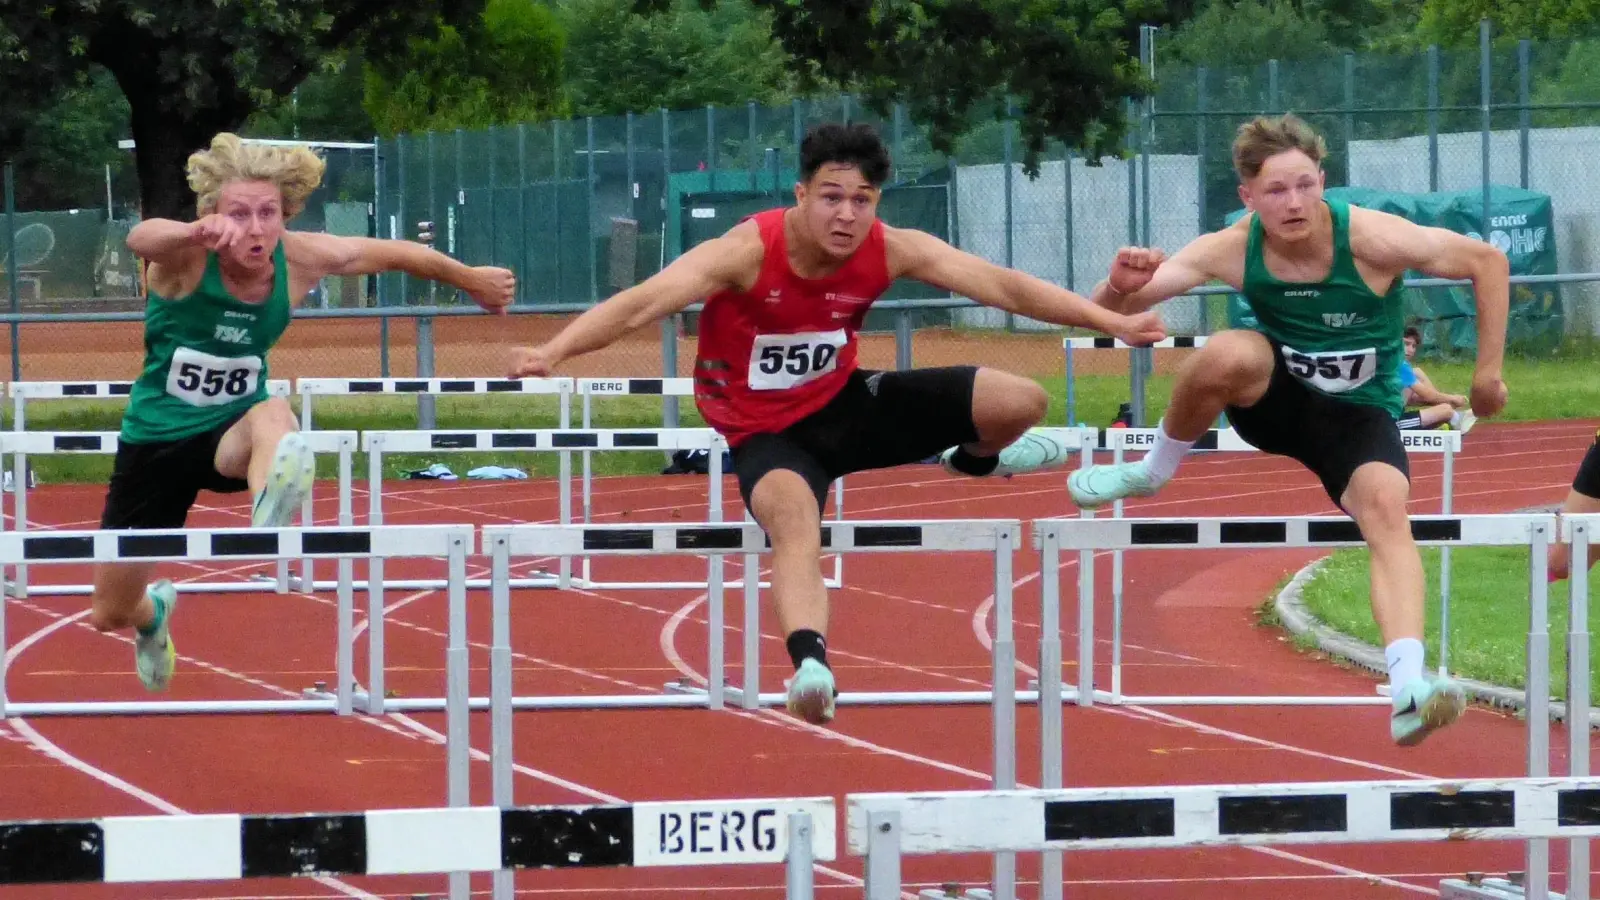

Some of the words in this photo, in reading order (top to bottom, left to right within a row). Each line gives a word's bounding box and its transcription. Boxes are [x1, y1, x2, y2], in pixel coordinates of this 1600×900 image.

[1321, 313, 1356, 328] TSV
[214, 324, 249, 343] TSV
[759, 343, 836, 376] 550
[1291, 353, 1366, 380] 557
[177, 362, 250, 397] 558
[591, 382, 623, 391] BERG
[1125, 434, 1155, 445] BER
[1403, 436, 1442, 447] BERG
[660, 809, 776, 853] BERG
